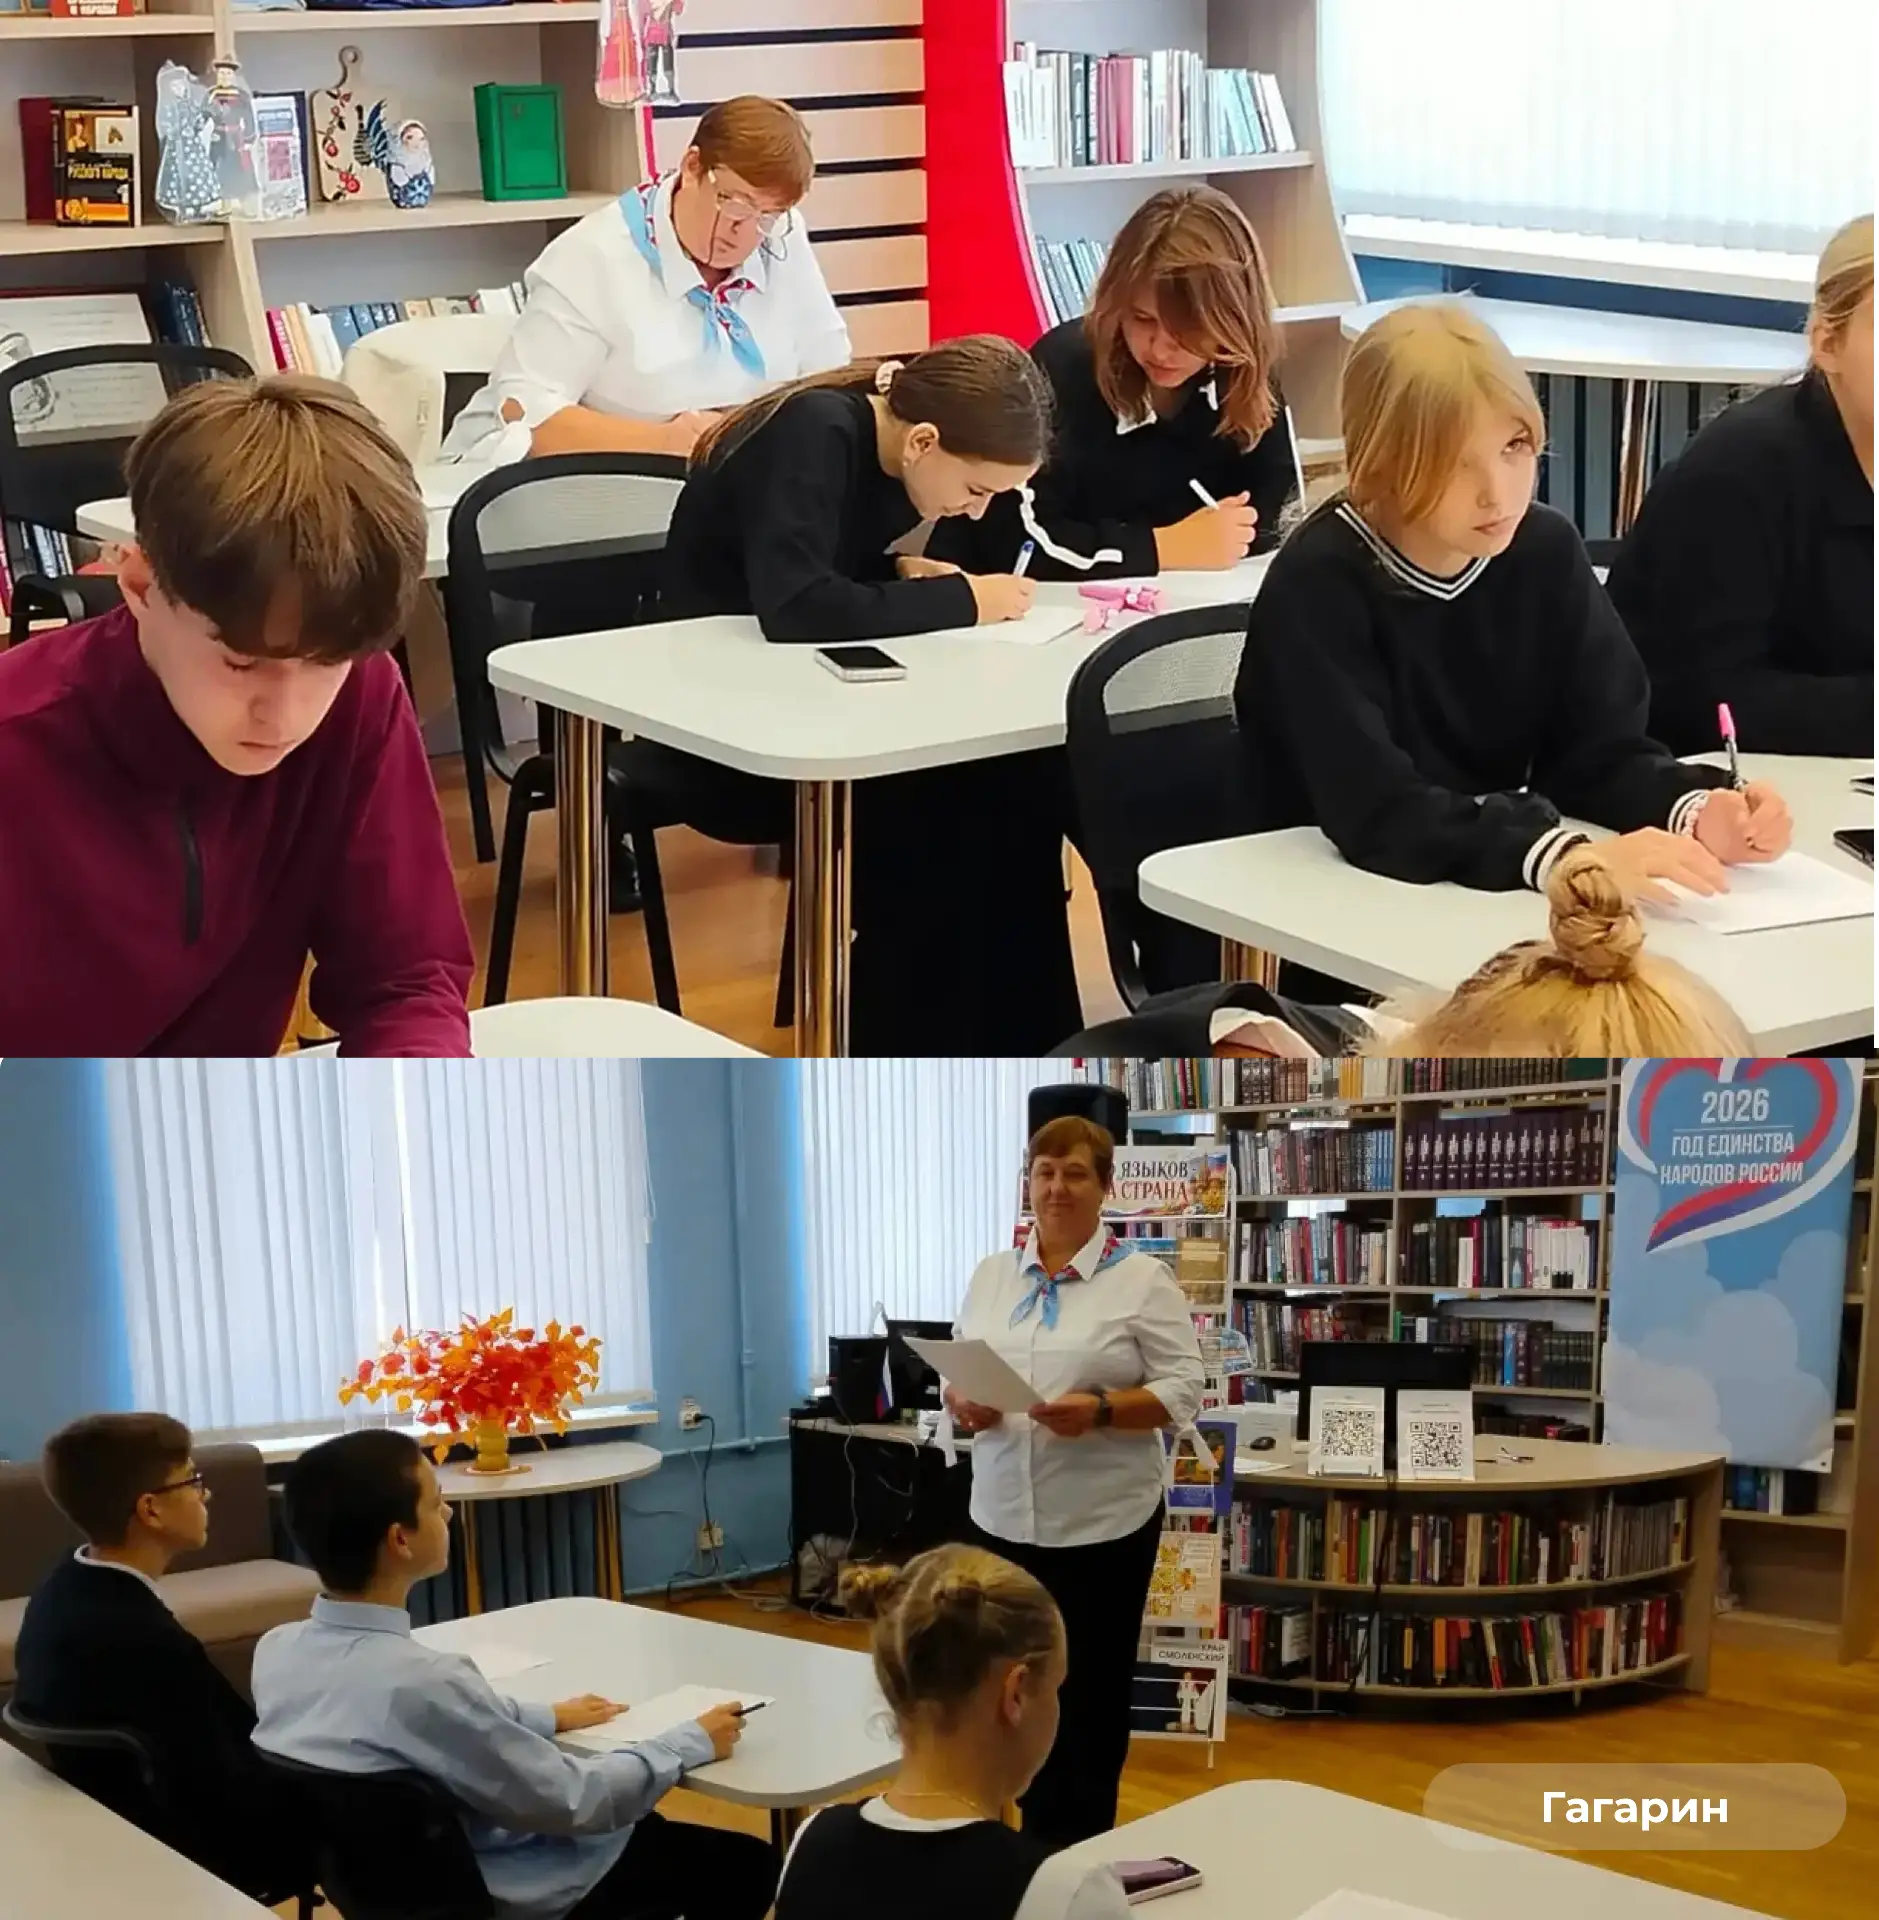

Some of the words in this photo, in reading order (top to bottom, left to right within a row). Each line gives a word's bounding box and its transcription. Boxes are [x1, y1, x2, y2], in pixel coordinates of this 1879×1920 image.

[1701, 1088, 1769, 1124] 2026
[1672, 1135, 1704, 1158] ГОД
[1708, 1131, 1795, 1156] ЕДИНСТВА
[1121, 1160, 1188, 1179] ЯЗЫКОВ
[1660, 1162, 1735, 1186] НАРОДОВ
[1737, 1160, 1804, 1184] РОССИИ
[1121, 1181, 1188, 1203] СТРАНА
[1158, 1651, 1225, 1662] СМОЛЕНСКИЙ
